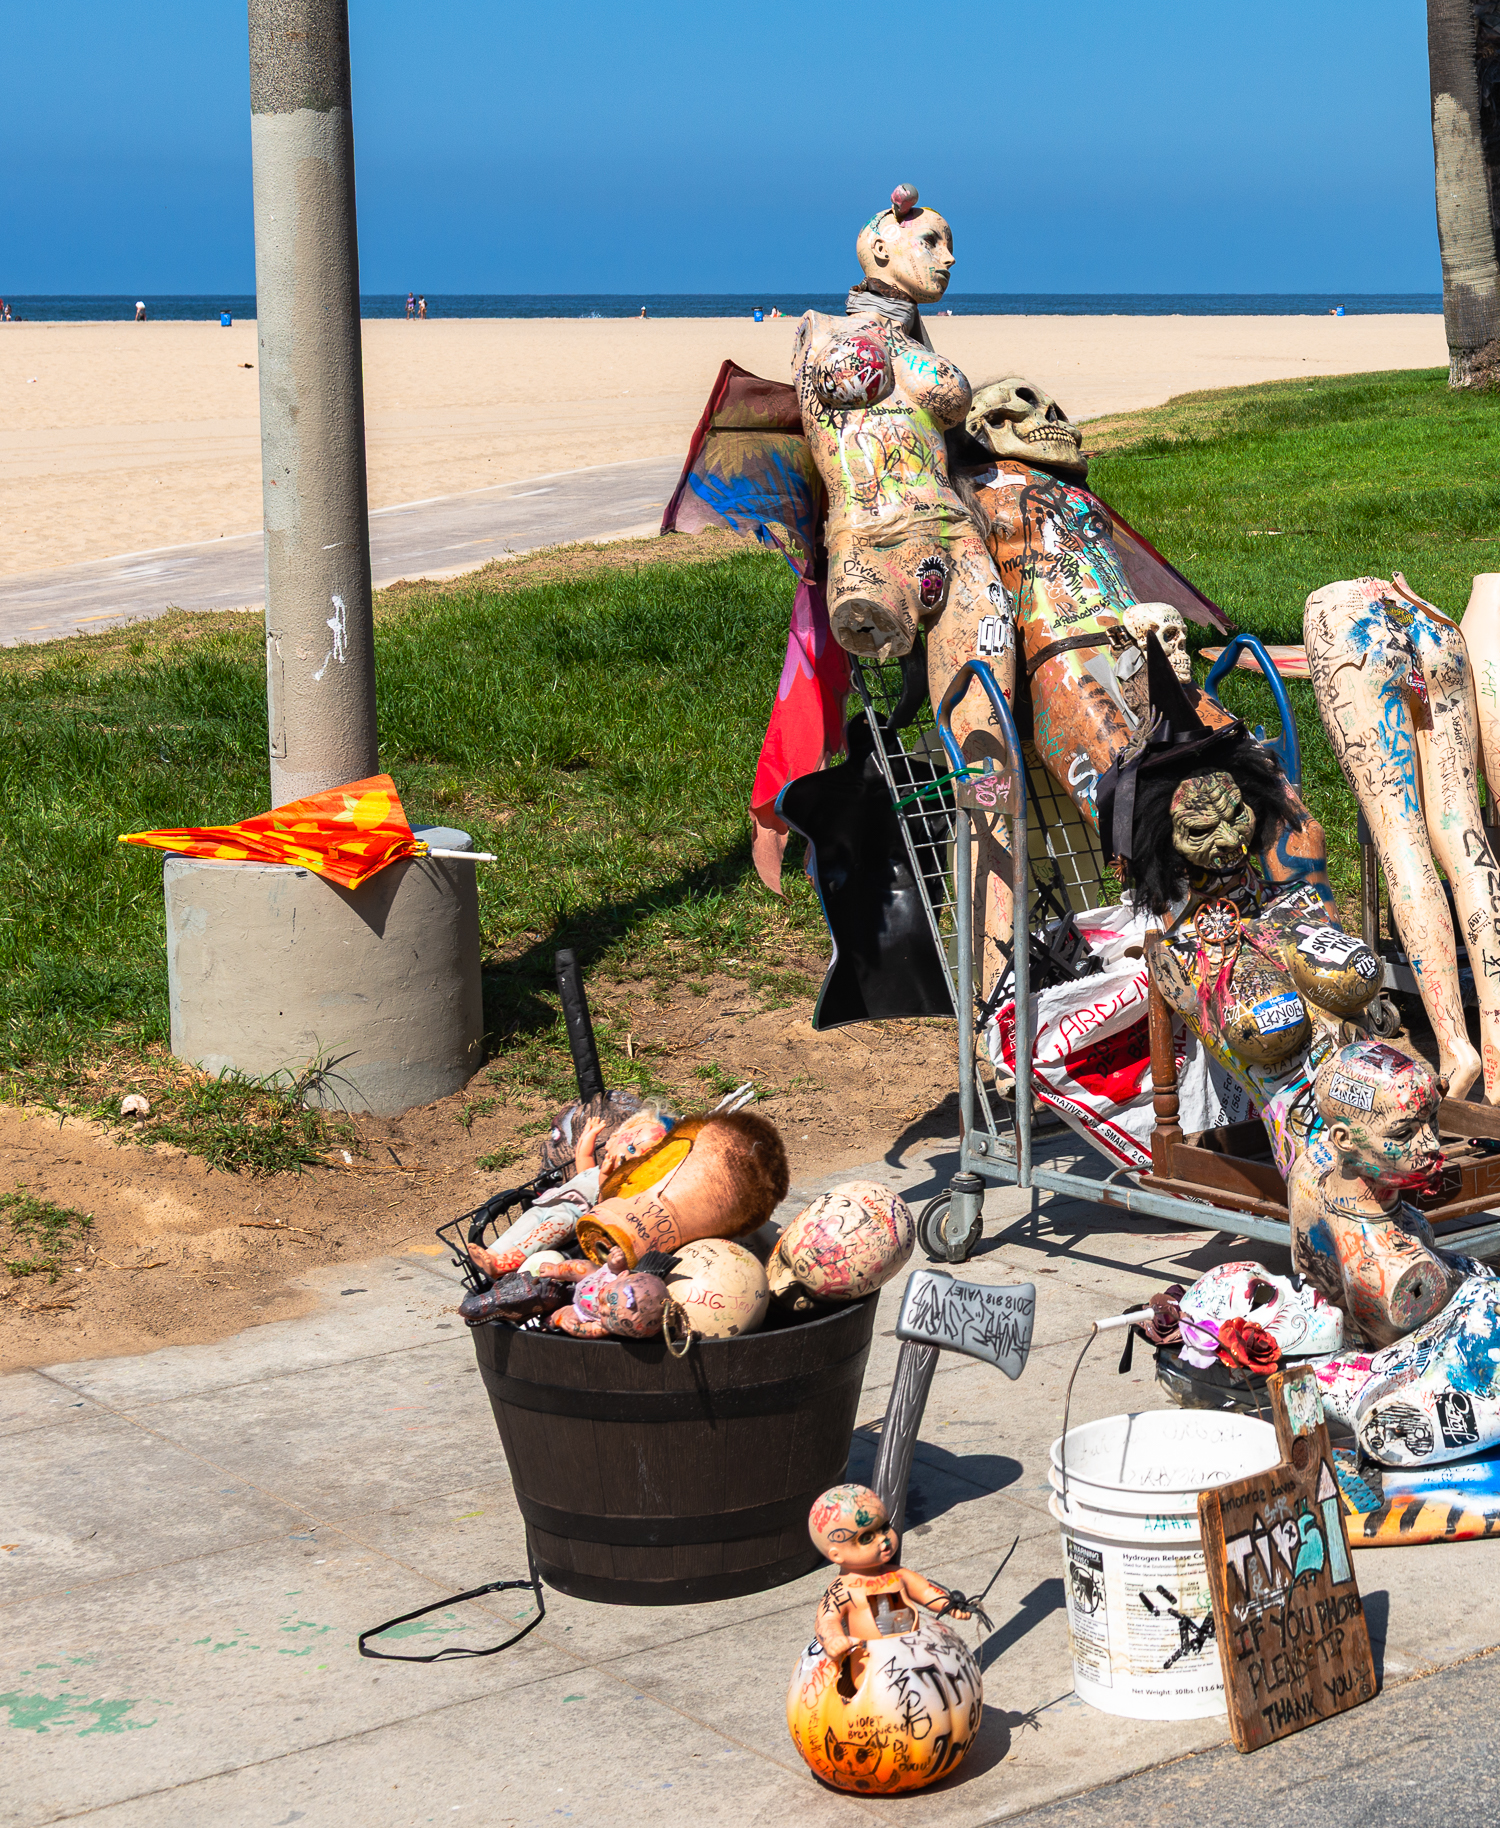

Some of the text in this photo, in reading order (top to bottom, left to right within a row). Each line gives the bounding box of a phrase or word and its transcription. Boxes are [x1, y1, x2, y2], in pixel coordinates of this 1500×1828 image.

[1103, 1128, 1129, 1151] SMALL
[1123, 1553, 1160, 1563] Hydrogen
[1162, 1554, 1192, 1562] Release
[1233, 1614, 1265, 1662] IF
[1269, 1604, 1316, 1648] YOU
[1315, 1627, 1346, 1665] TIP
[1131, 1688, 1144, 1696] Net
[1146, 1687, 1173, 1698] Weight:
[1197, 1684, 1215, 1695] (13.6
[1261, 1687, 1323, 1735] THANK
